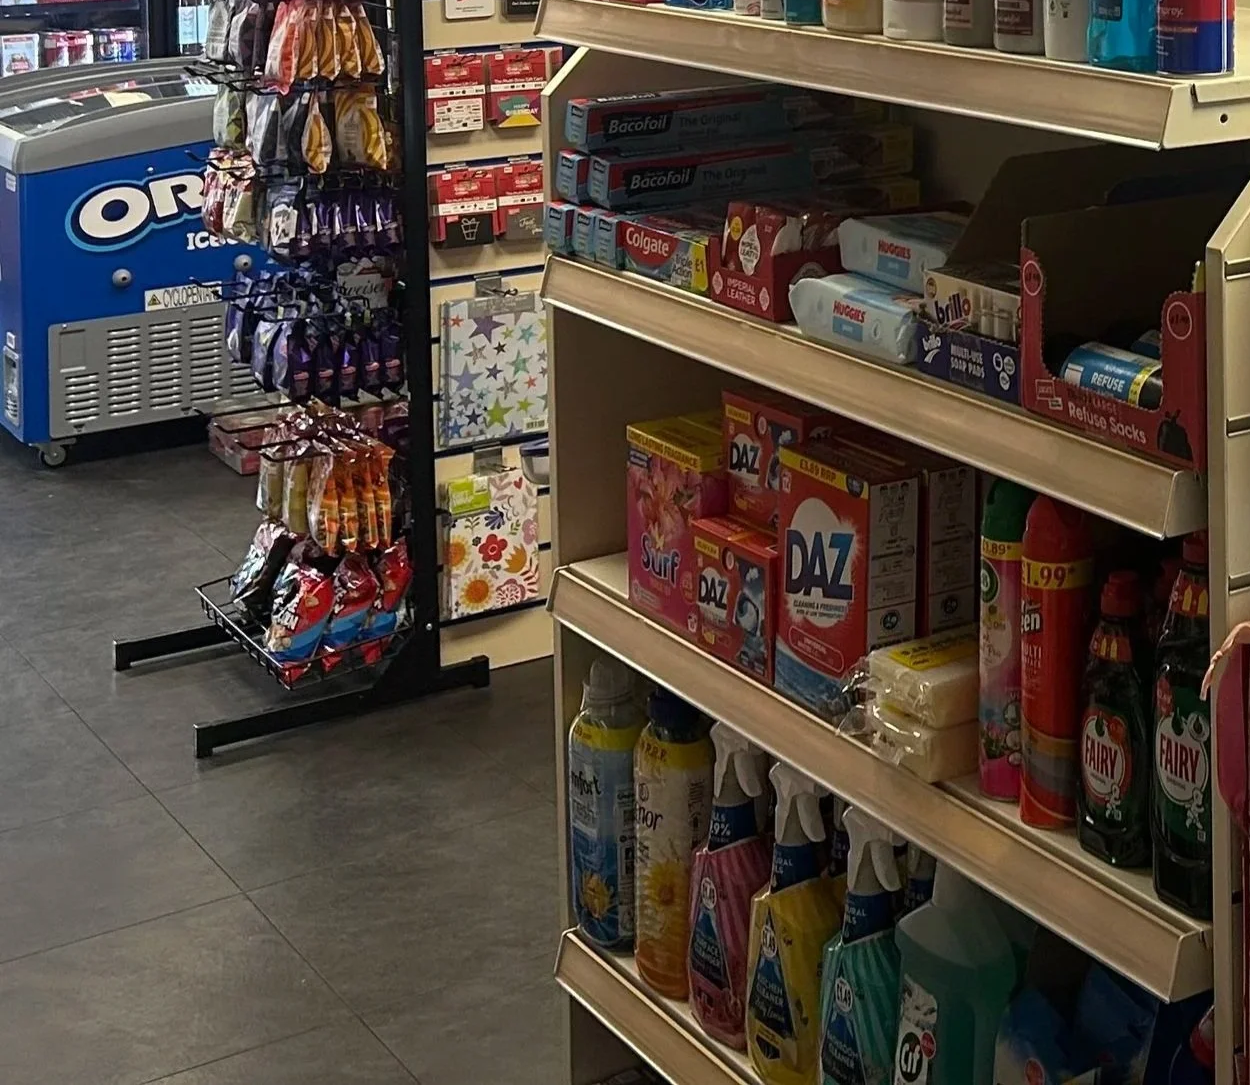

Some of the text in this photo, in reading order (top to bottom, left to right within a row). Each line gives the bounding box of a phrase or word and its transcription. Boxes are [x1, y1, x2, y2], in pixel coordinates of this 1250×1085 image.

[608, 115, 668, 135] Bacofoil
[630, 168, 692, 190] Bacofoil
[78, 173, 205, 240] OR
[625, 226, 670, 258] Colgate
[878, 239, 912, 260] HUGGIES
[726, 277, 755, 295] IMPERIAL
[726, 288, 756, 307] LEATHER
[832, 299, 866, 324] HUGGIES
[934, 293, 972, 325] brillo
[923, 334, 942, 353] brillo
[950, 345, 984, 365] MULTI-USE
[950, 356, 986, 380] SOAP PADS
[1090, 372, 1126, 393] REFUSE
[1067, 401, 1147, 445] Refuse Sacks
[729, 440, 761, 476] DAZ
[640, 531, 682, 588] Surf
[785, 528, 855, 601] DAZ
[698, 573, 729, 611] DAZ
[1084, 738, 1119, 776] FAIRY
[1159, 740, 1201, 777] FAIRY
[900, 1049, 920, 1075] Cif
